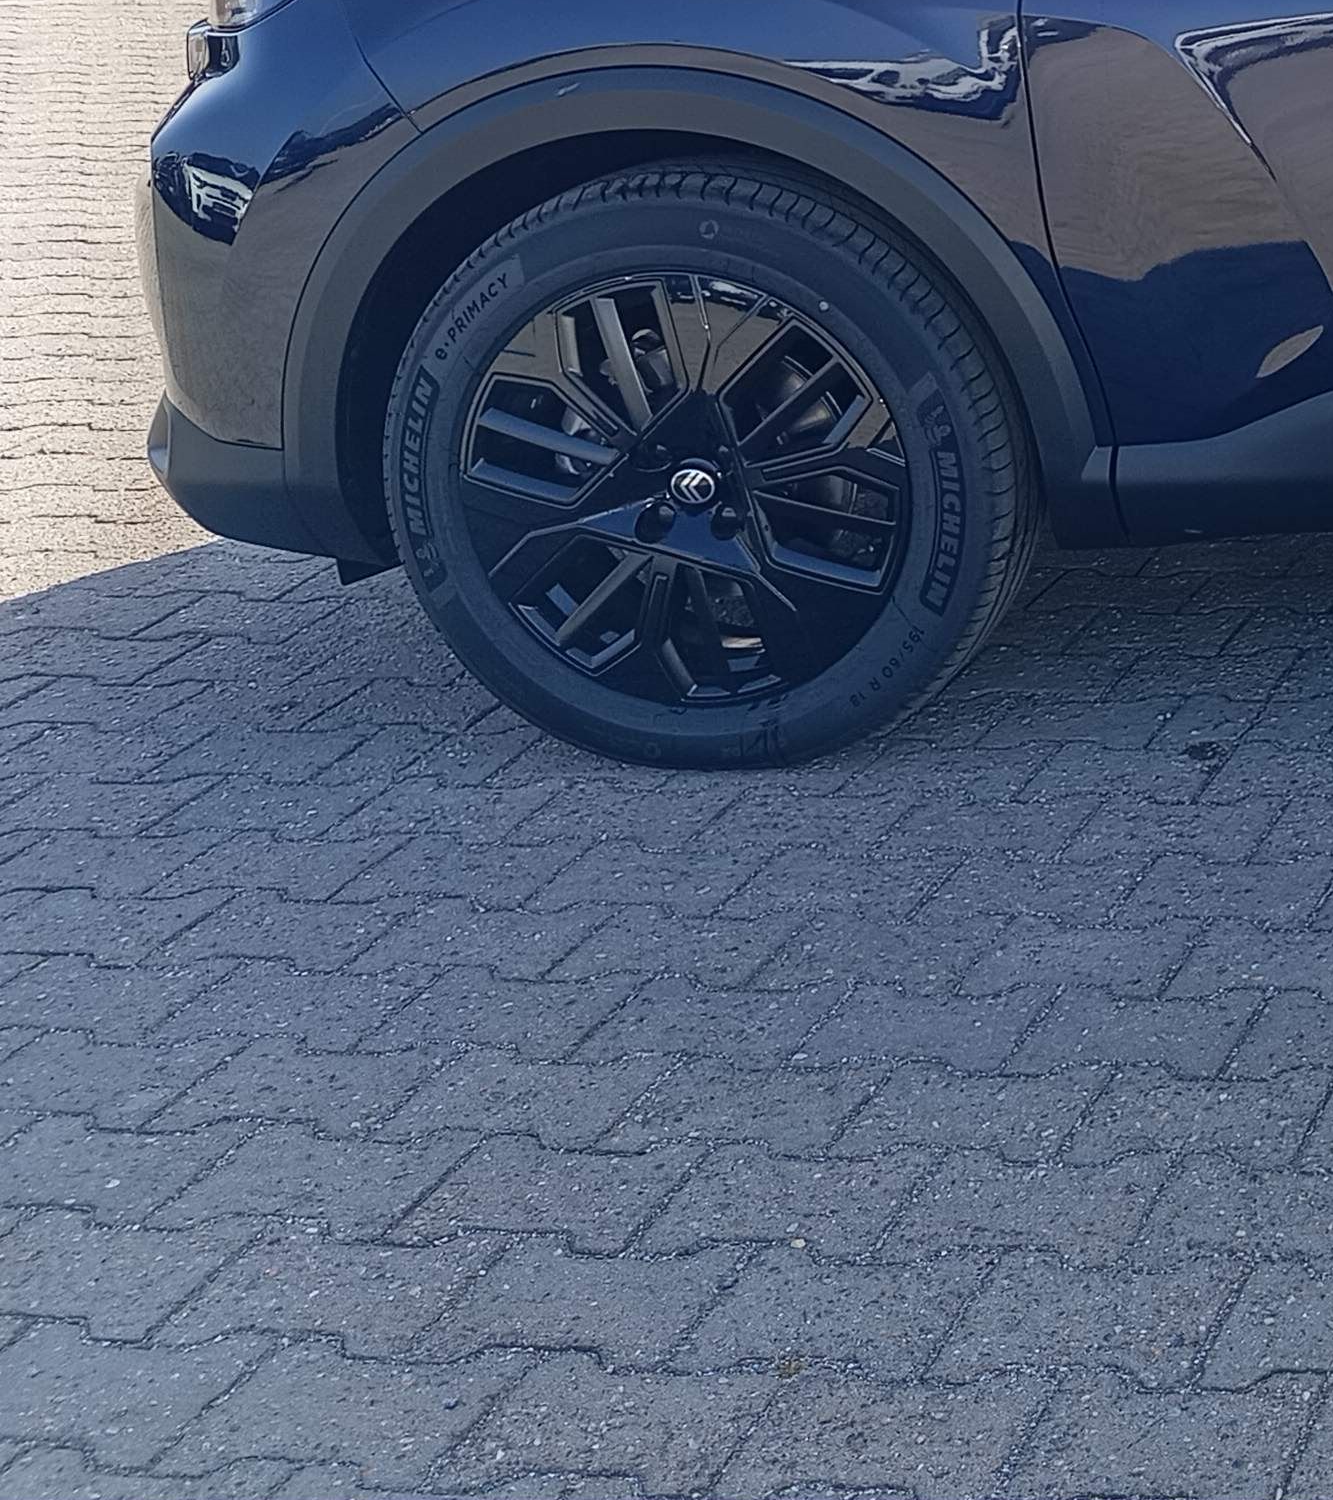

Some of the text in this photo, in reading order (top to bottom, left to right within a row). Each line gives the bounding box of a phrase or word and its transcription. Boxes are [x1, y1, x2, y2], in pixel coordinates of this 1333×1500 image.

[402, 378, 435, 538] MICHELIN
[924, 451, 962, 610] MICHELIN
[868, 678, 882, 692] R
